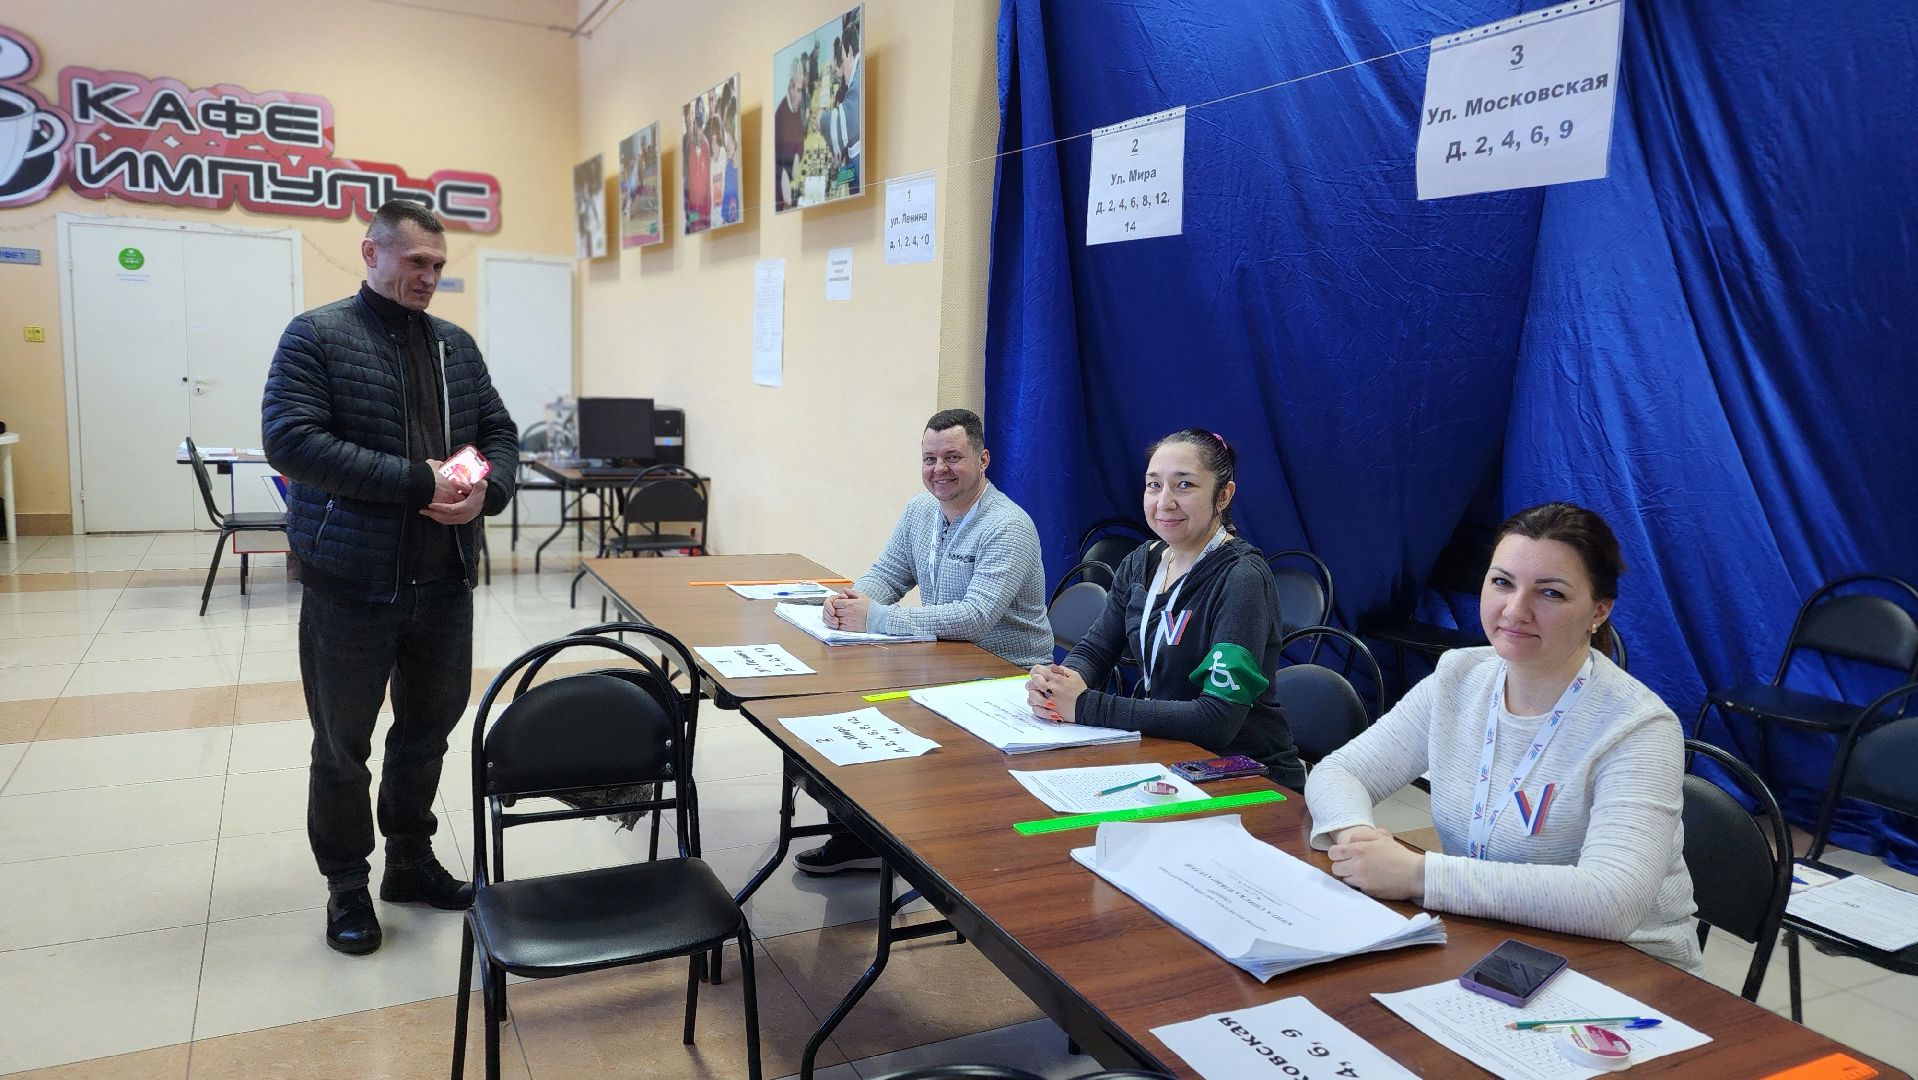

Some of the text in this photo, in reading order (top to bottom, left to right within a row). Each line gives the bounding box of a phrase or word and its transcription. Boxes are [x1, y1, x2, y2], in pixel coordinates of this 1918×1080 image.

[1510, 44, 1525, 66] 3
[1426, 73, 1610, 126] Ул. Московская
[75, 80, 321, 146] КАФЕ
[1131, 138, 1139, 153] 2
[1445, 119, 1574, 164] Д. 2, 4, 6, 9
[77, 146, 490, 220] ИМПУЛЬС
[1110, 168, 1157, 186] Ул. Мира
[907, 188, 912, 200] 1
[1108, 199, 1116, 213] 2,
[1118, 198, 1128, 212] 4,
[1130, 196, 1139, 210] 6,
[1142, 194, 1152, 208] 8,
[1155, 191, 1170, 207] 12,
[890, 212, 928, 228] ул. Ленина
[1124, 220, 1136, 233] 14
[920, 233, 930, 246] 0
[1280, 1028, 1361, 1079] 4, 6, 9
